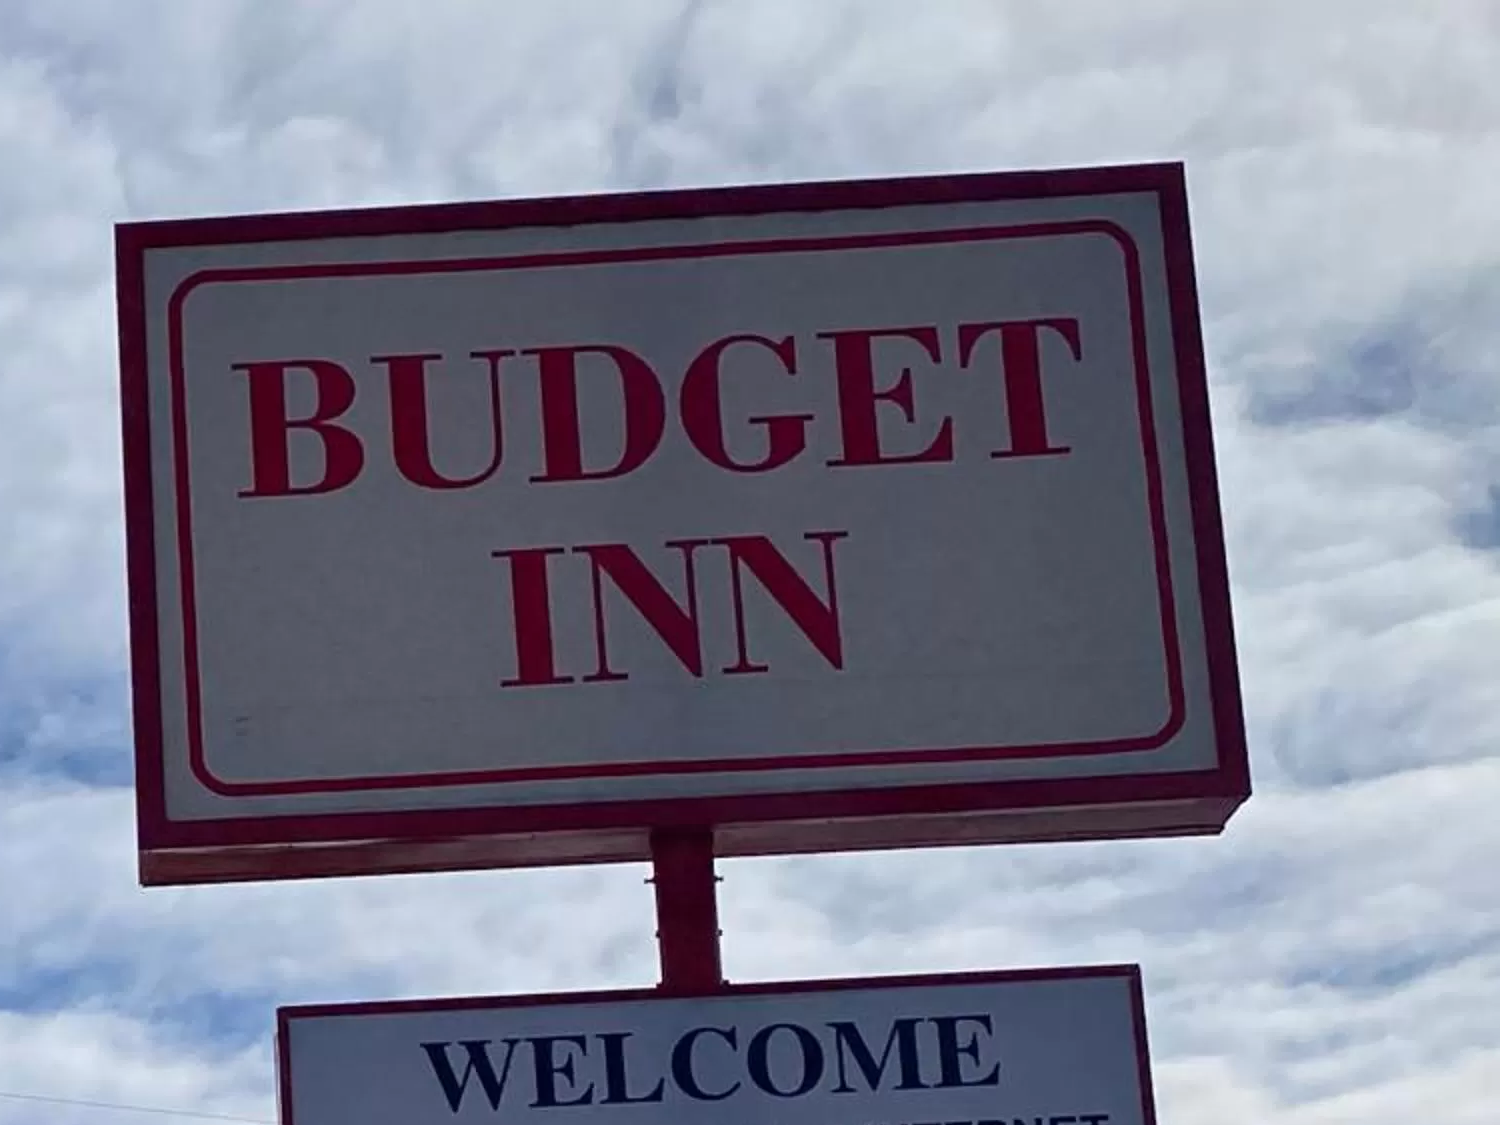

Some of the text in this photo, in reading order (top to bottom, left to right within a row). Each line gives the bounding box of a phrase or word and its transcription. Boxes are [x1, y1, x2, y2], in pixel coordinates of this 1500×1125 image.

[230, 316, 1083, 499] BUDGET
[491, 529, 850, 688] INN
[419, 1012, 1002, 1115] WELCOME
